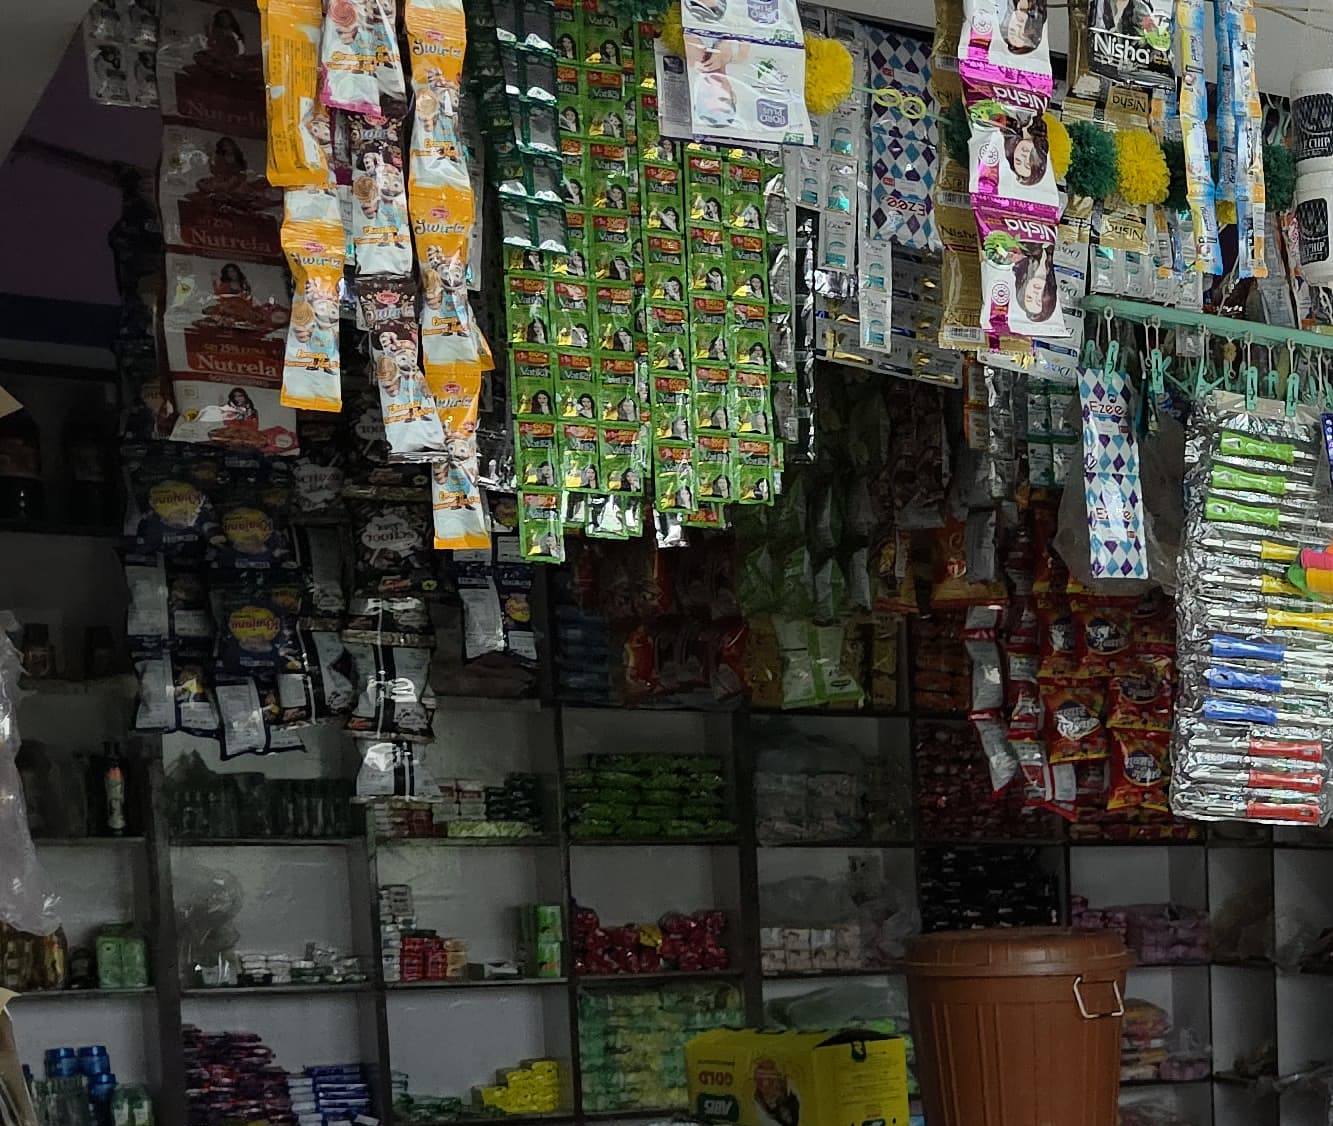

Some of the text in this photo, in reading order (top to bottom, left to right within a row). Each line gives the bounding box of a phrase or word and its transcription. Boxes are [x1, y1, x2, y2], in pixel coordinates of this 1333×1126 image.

[1093, 32, 1151, 65] Nisha
[993, 84, 1050, 114] Nisha
[1112, 93, 1147, 114] Nisha
[885, 196, 927, 217] Ezee
[1004, 216, 1059, 245] Nisha
[197, 354, 278, 379] Nutrela
[1088, 399, 1127, 417] Ezee
[1095, 505, 1132, 521] Eze
[698, 1069, 734, 1086] GOLD
[704, 1099, 734, 1116] ABIS
